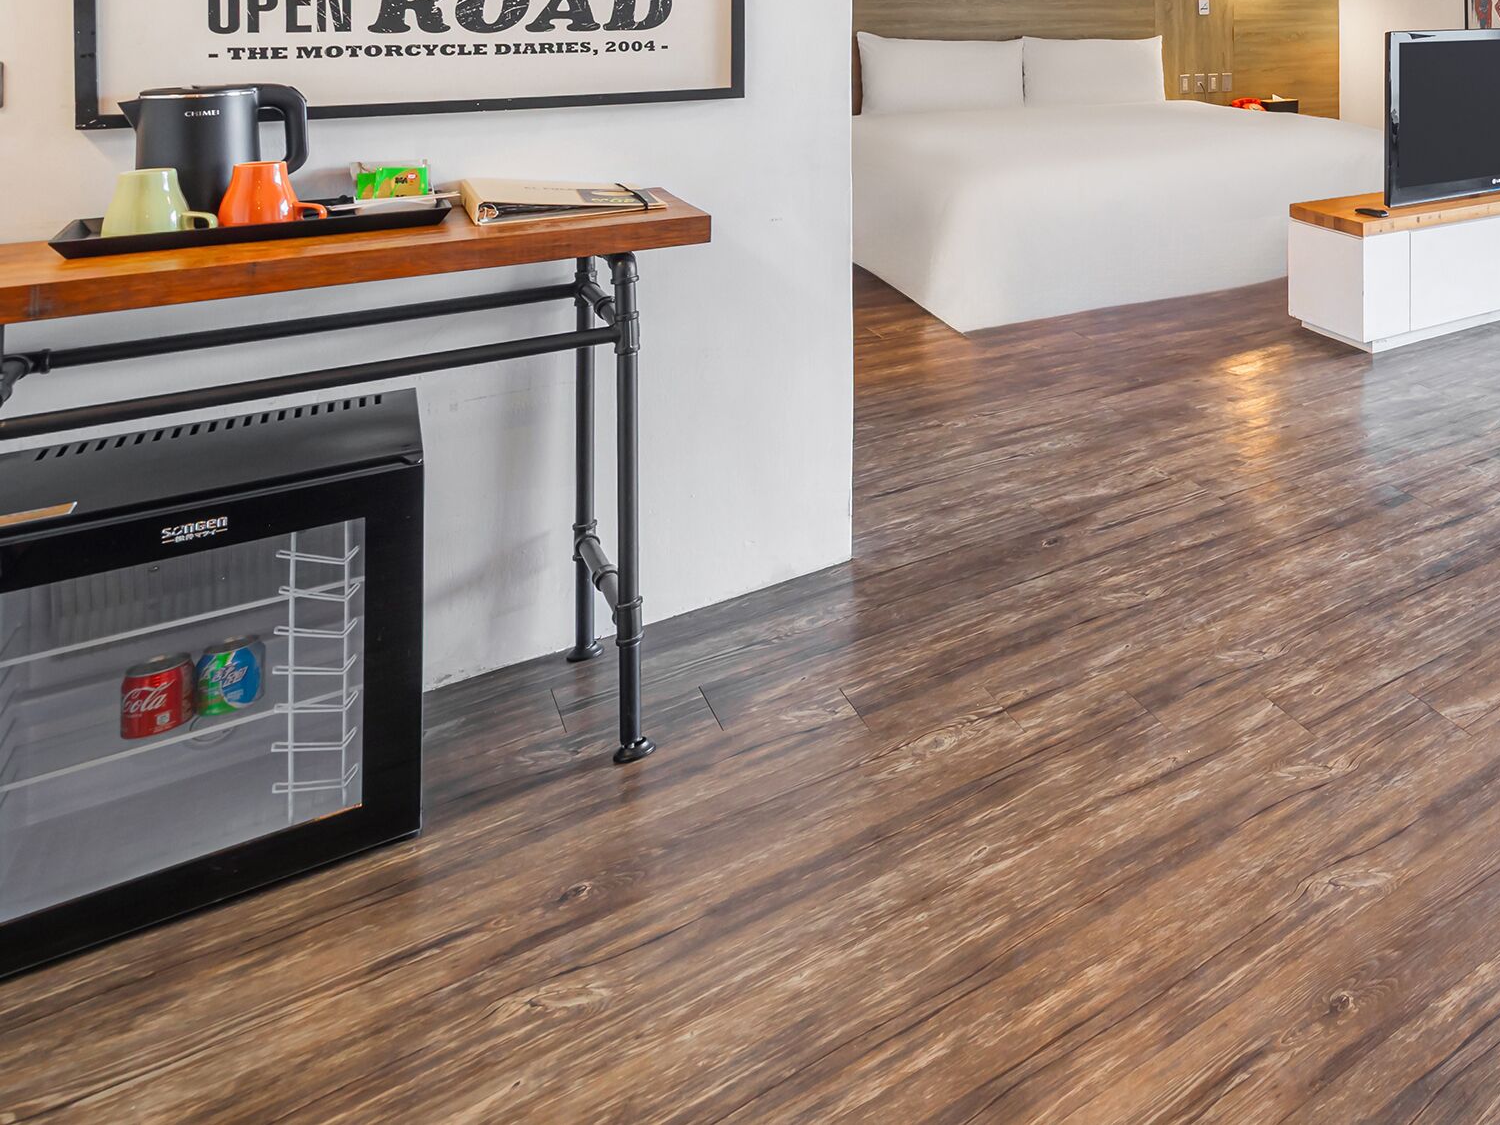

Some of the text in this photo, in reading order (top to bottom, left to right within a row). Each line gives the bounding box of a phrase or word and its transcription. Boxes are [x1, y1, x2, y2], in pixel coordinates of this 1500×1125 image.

[226, 46, 288, 61] THE
[296, 43, 488, 59] MOTORCYCLE
[494, 41, 599, 57] DIARIES,
[605, 40, 656, 53] 2004
[184, 109, 220, 118] CHIMEI
